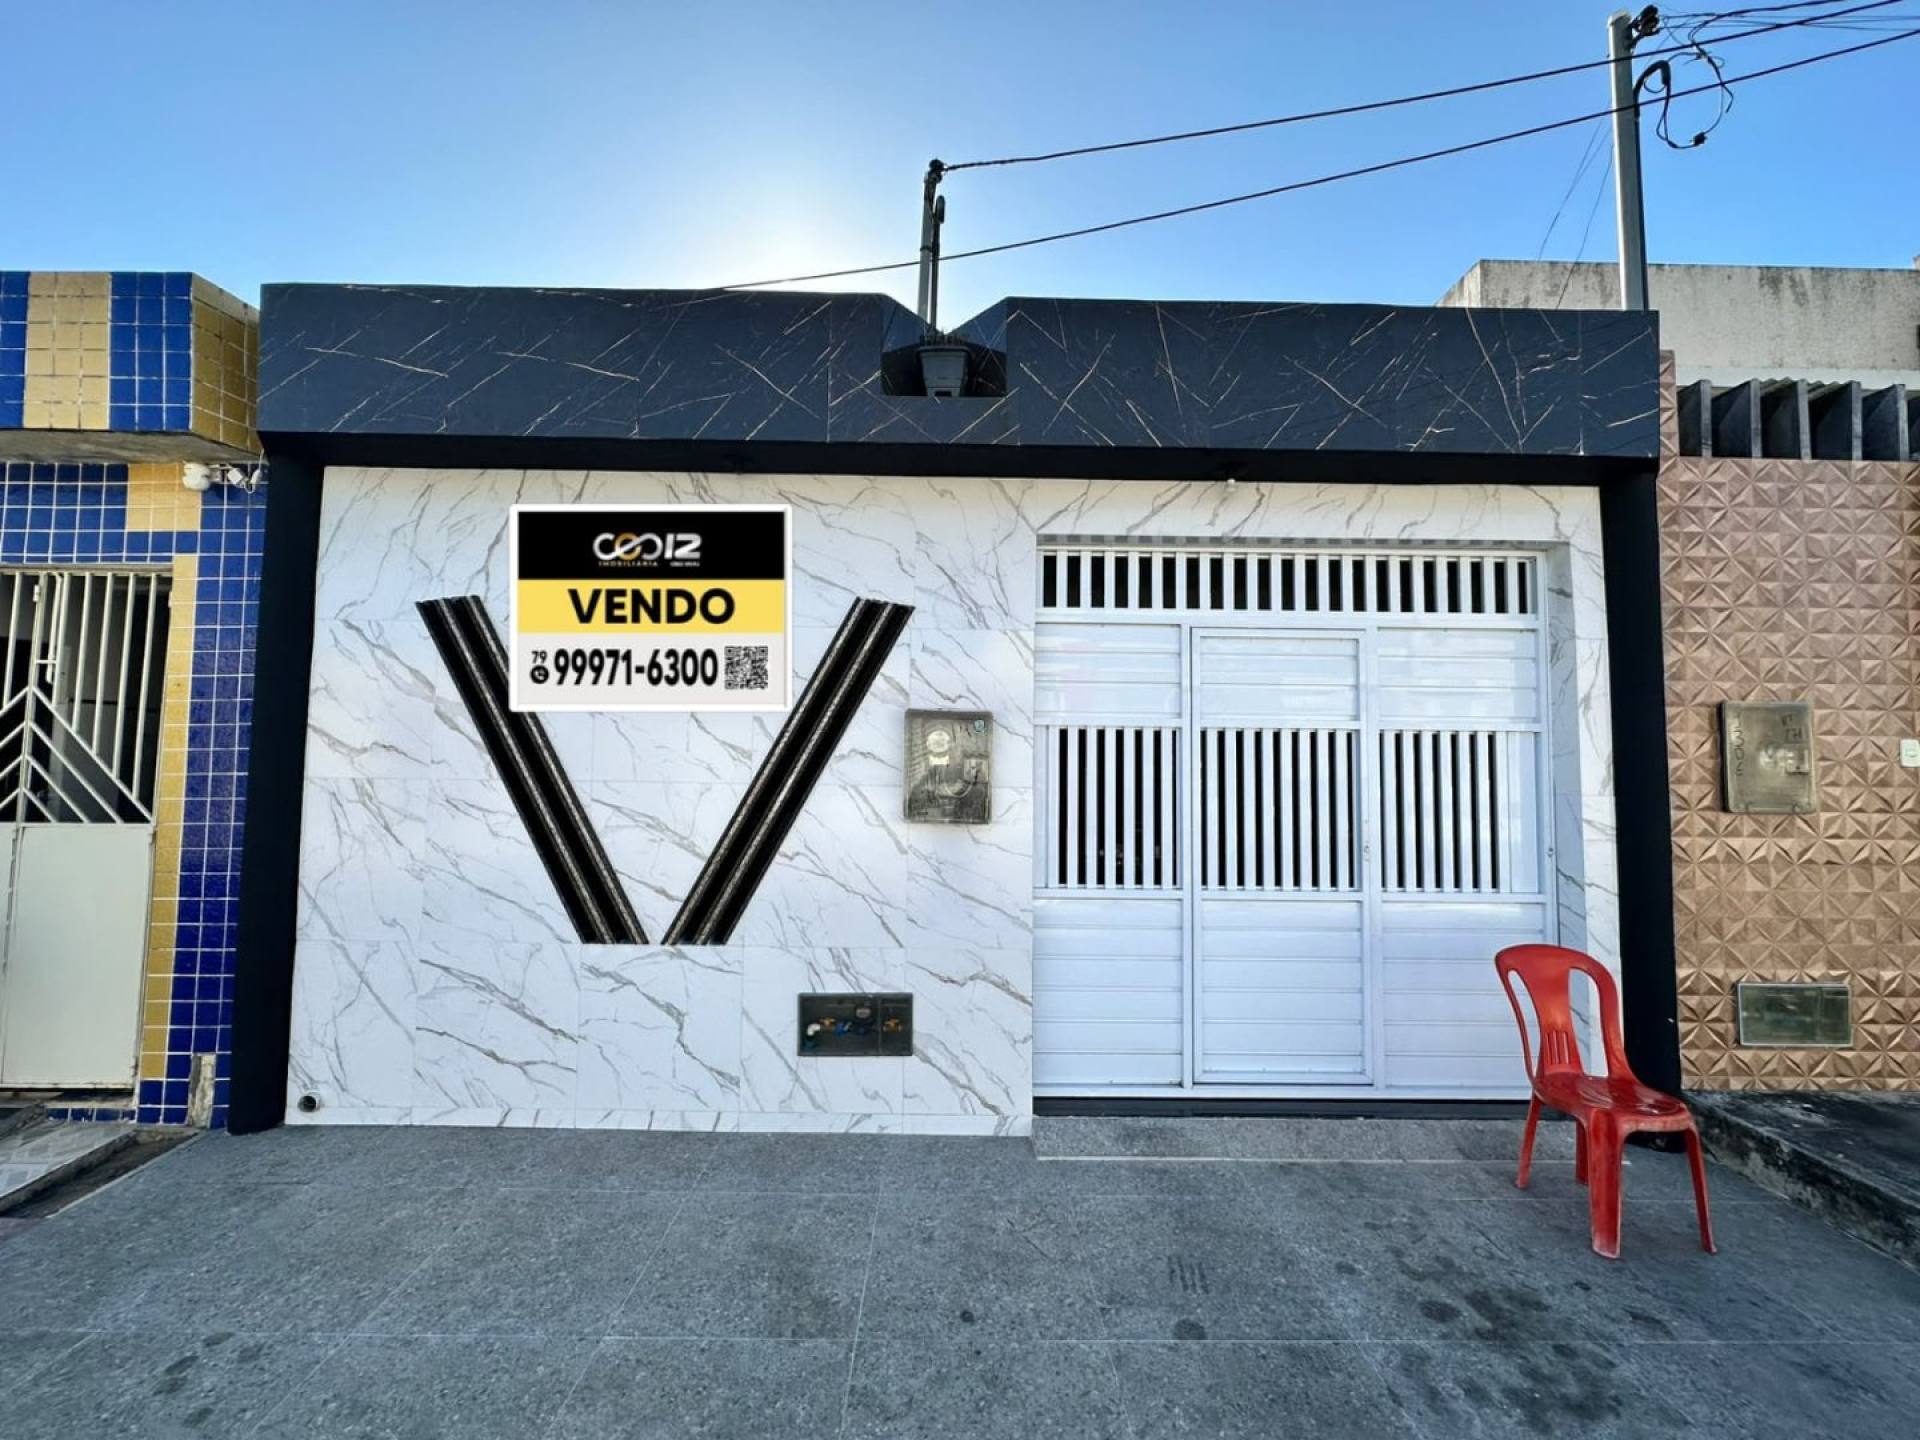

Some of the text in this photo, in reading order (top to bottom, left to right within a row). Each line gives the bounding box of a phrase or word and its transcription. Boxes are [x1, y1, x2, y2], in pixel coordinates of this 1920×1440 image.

[568, 588, 735, 624] VENDO
[531, 650, 547, 664] 79
[554, 648, 718, 686] 99971-6300
